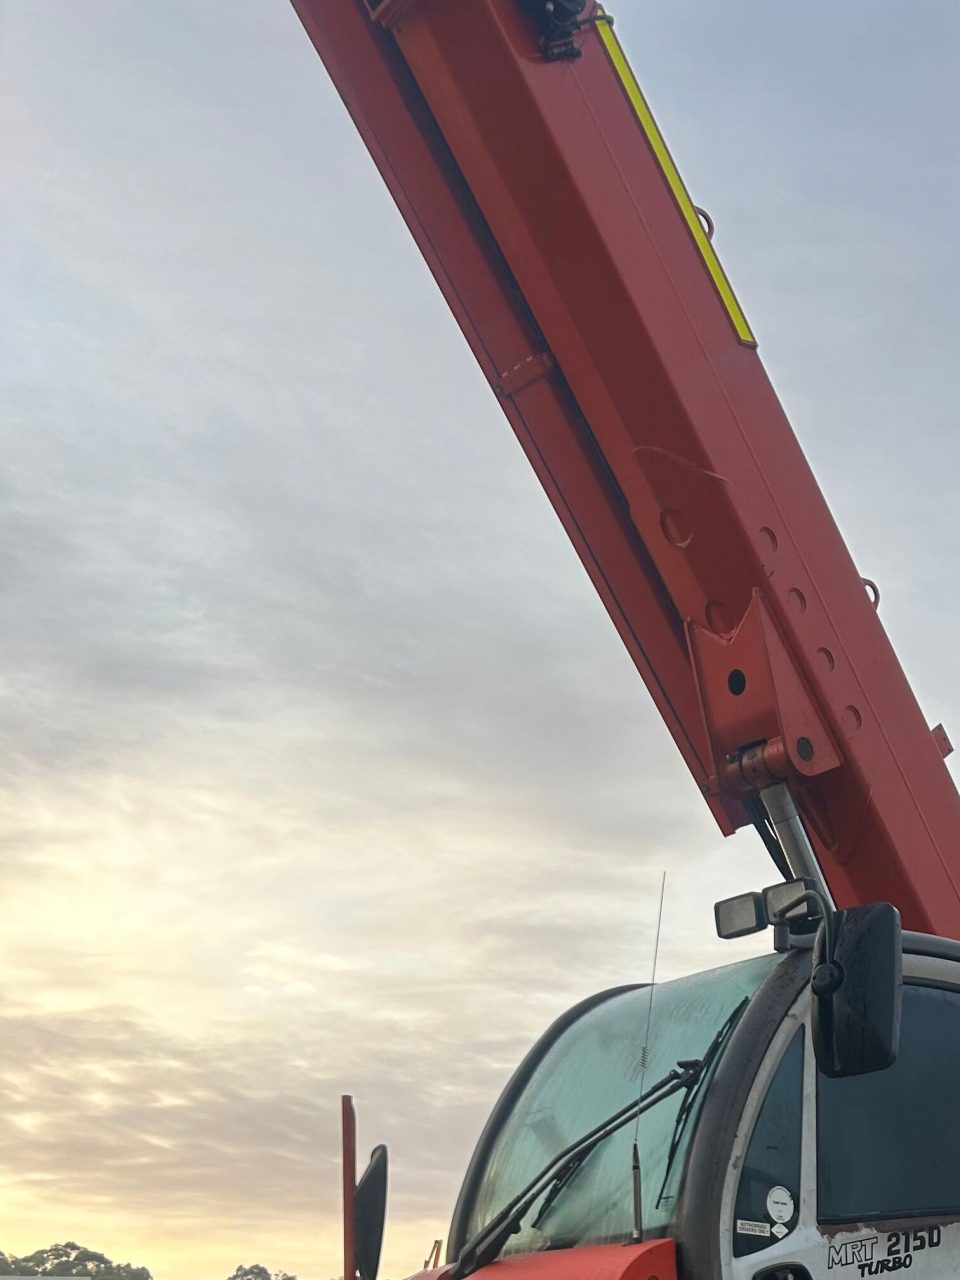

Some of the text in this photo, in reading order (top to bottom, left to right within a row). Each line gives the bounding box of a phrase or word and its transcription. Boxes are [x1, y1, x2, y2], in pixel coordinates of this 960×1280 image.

[828, 1225, 941, 1269] MRT 2150
[858, 1254, 913, 1278] TURBO
